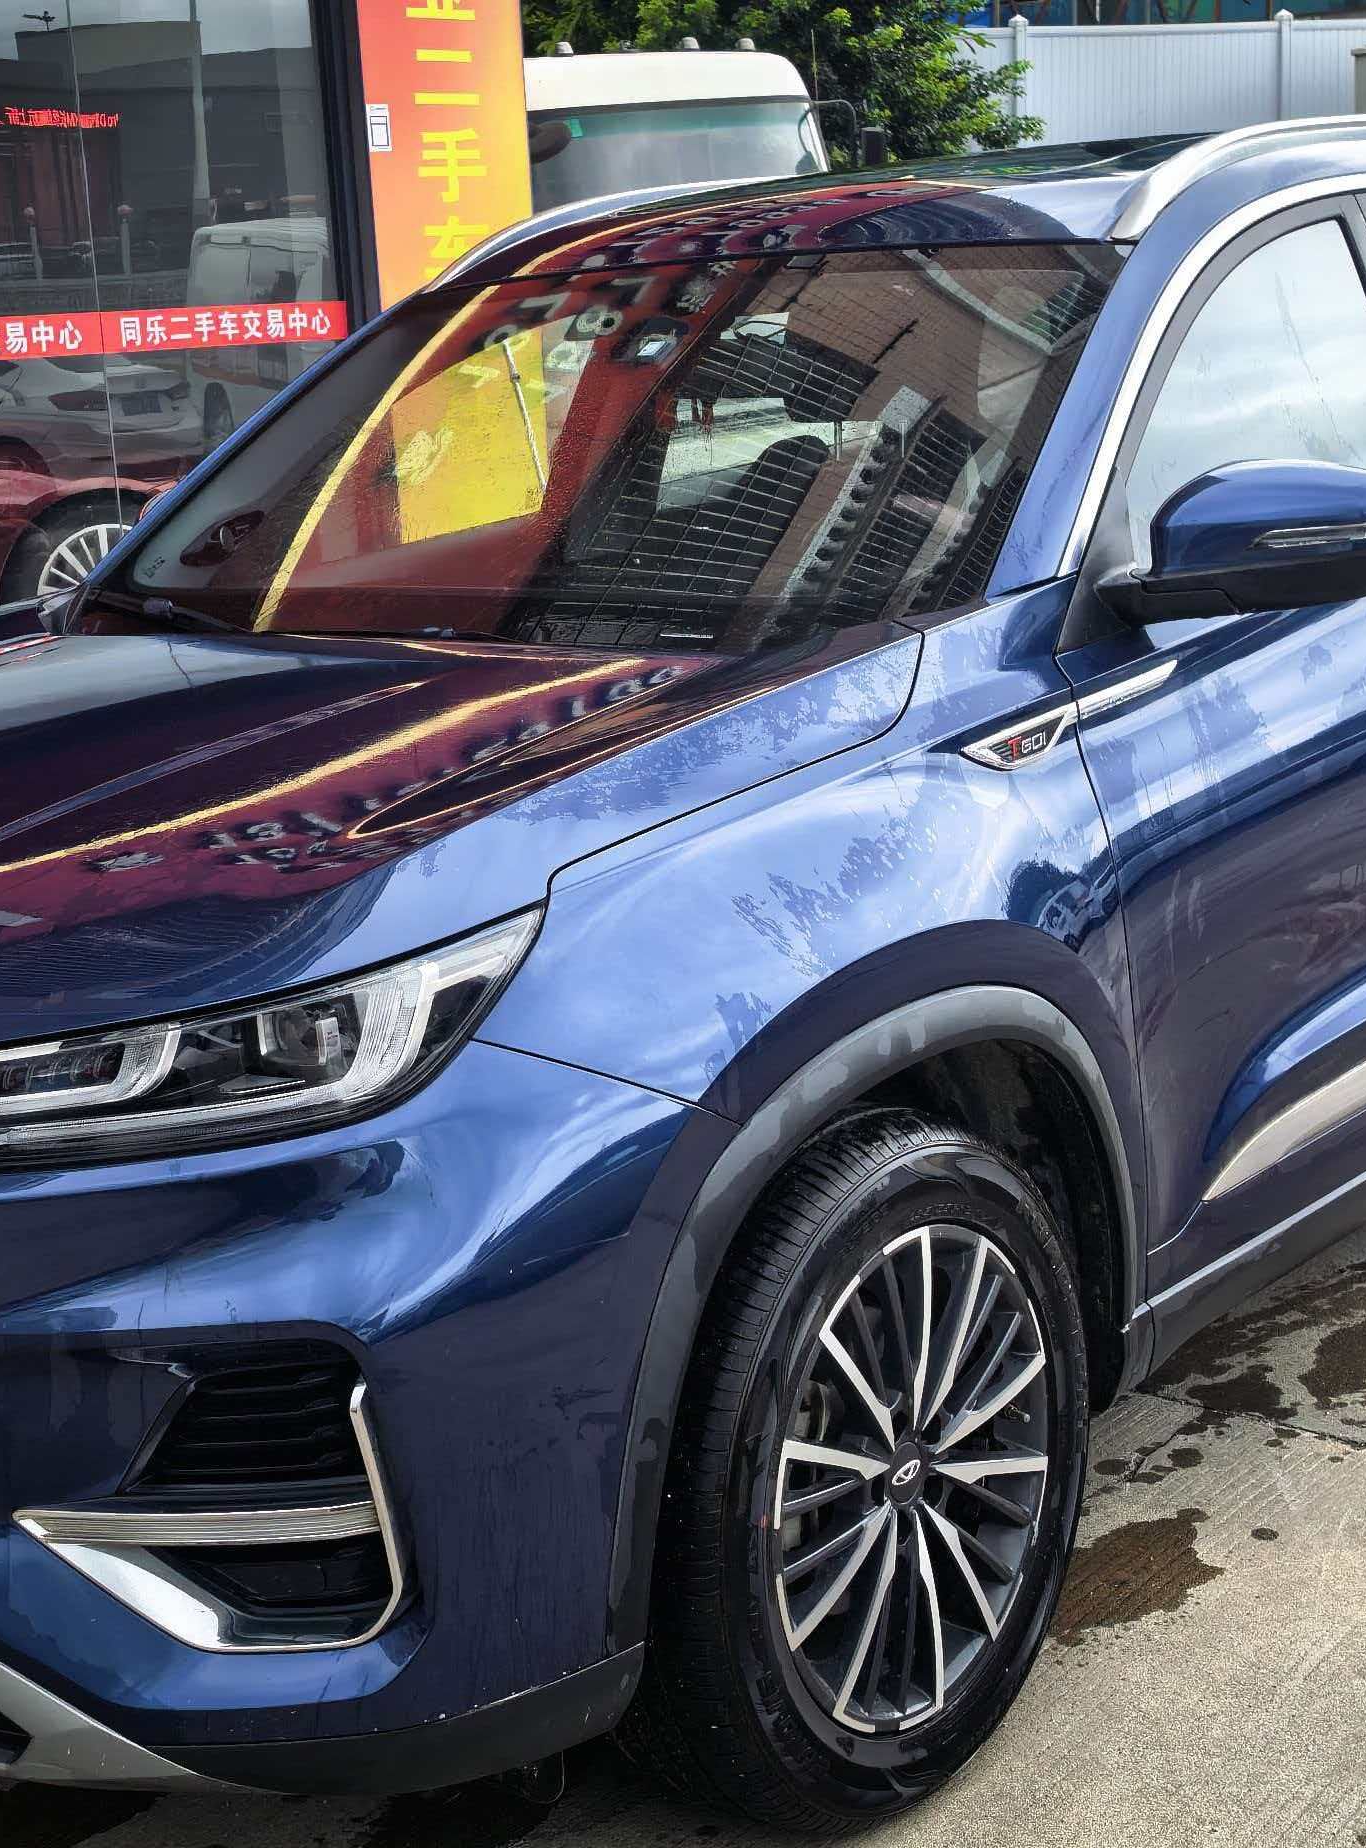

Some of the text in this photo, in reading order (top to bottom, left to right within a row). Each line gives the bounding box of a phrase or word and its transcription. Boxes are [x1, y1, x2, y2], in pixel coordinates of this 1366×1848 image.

[406, 0, 489, 281] 二手车
[120, 308, 331, 348] 同乐二手车交易中心
